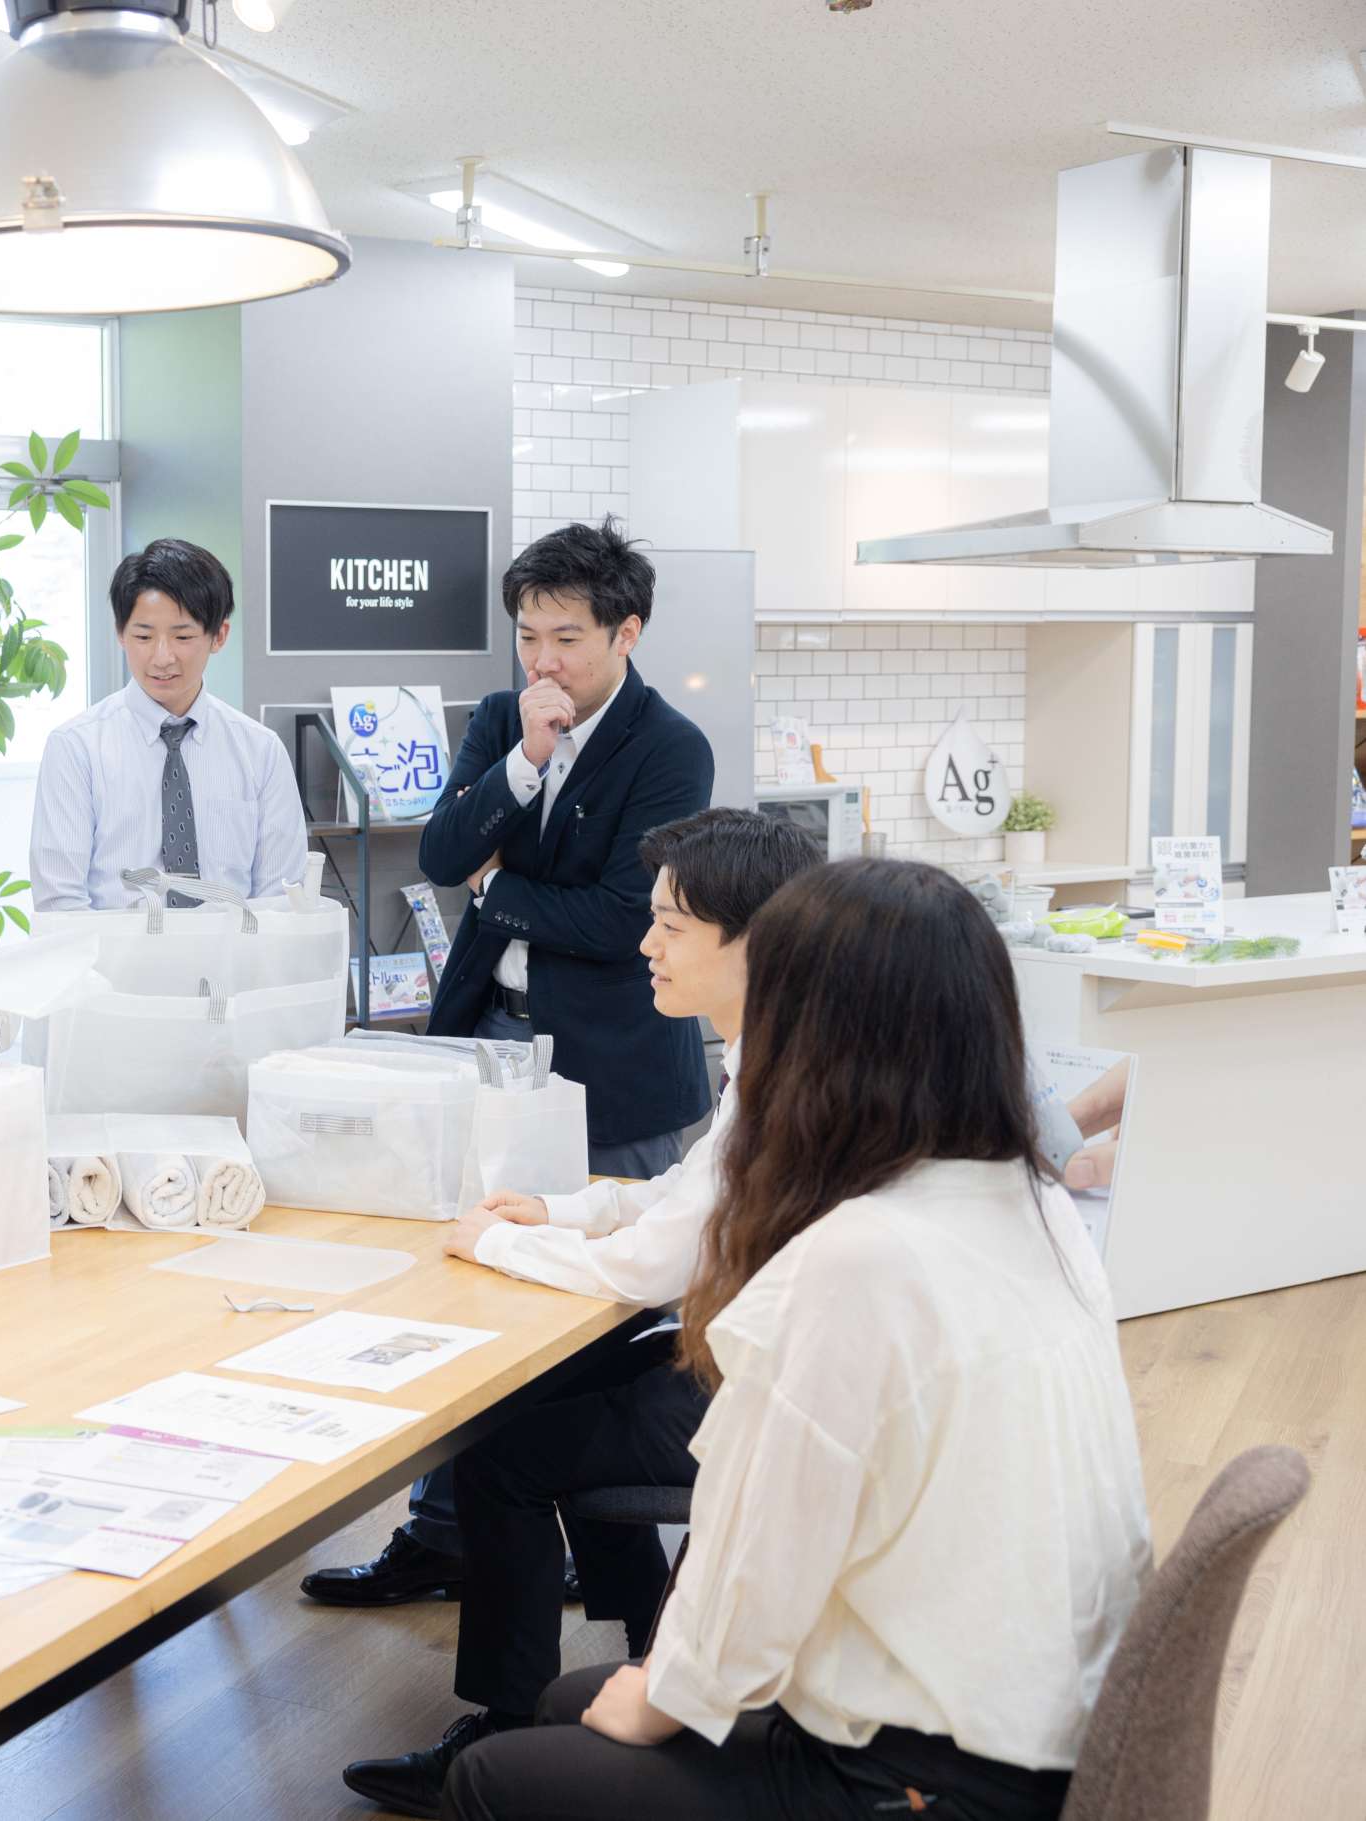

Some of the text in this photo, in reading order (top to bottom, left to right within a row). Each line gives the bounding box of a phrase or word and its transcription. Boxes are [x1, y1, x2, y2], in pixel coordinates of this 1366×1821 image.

[330, 558, 429, 591] KITCHEN
[345, 596, 414, 610] for your life style
